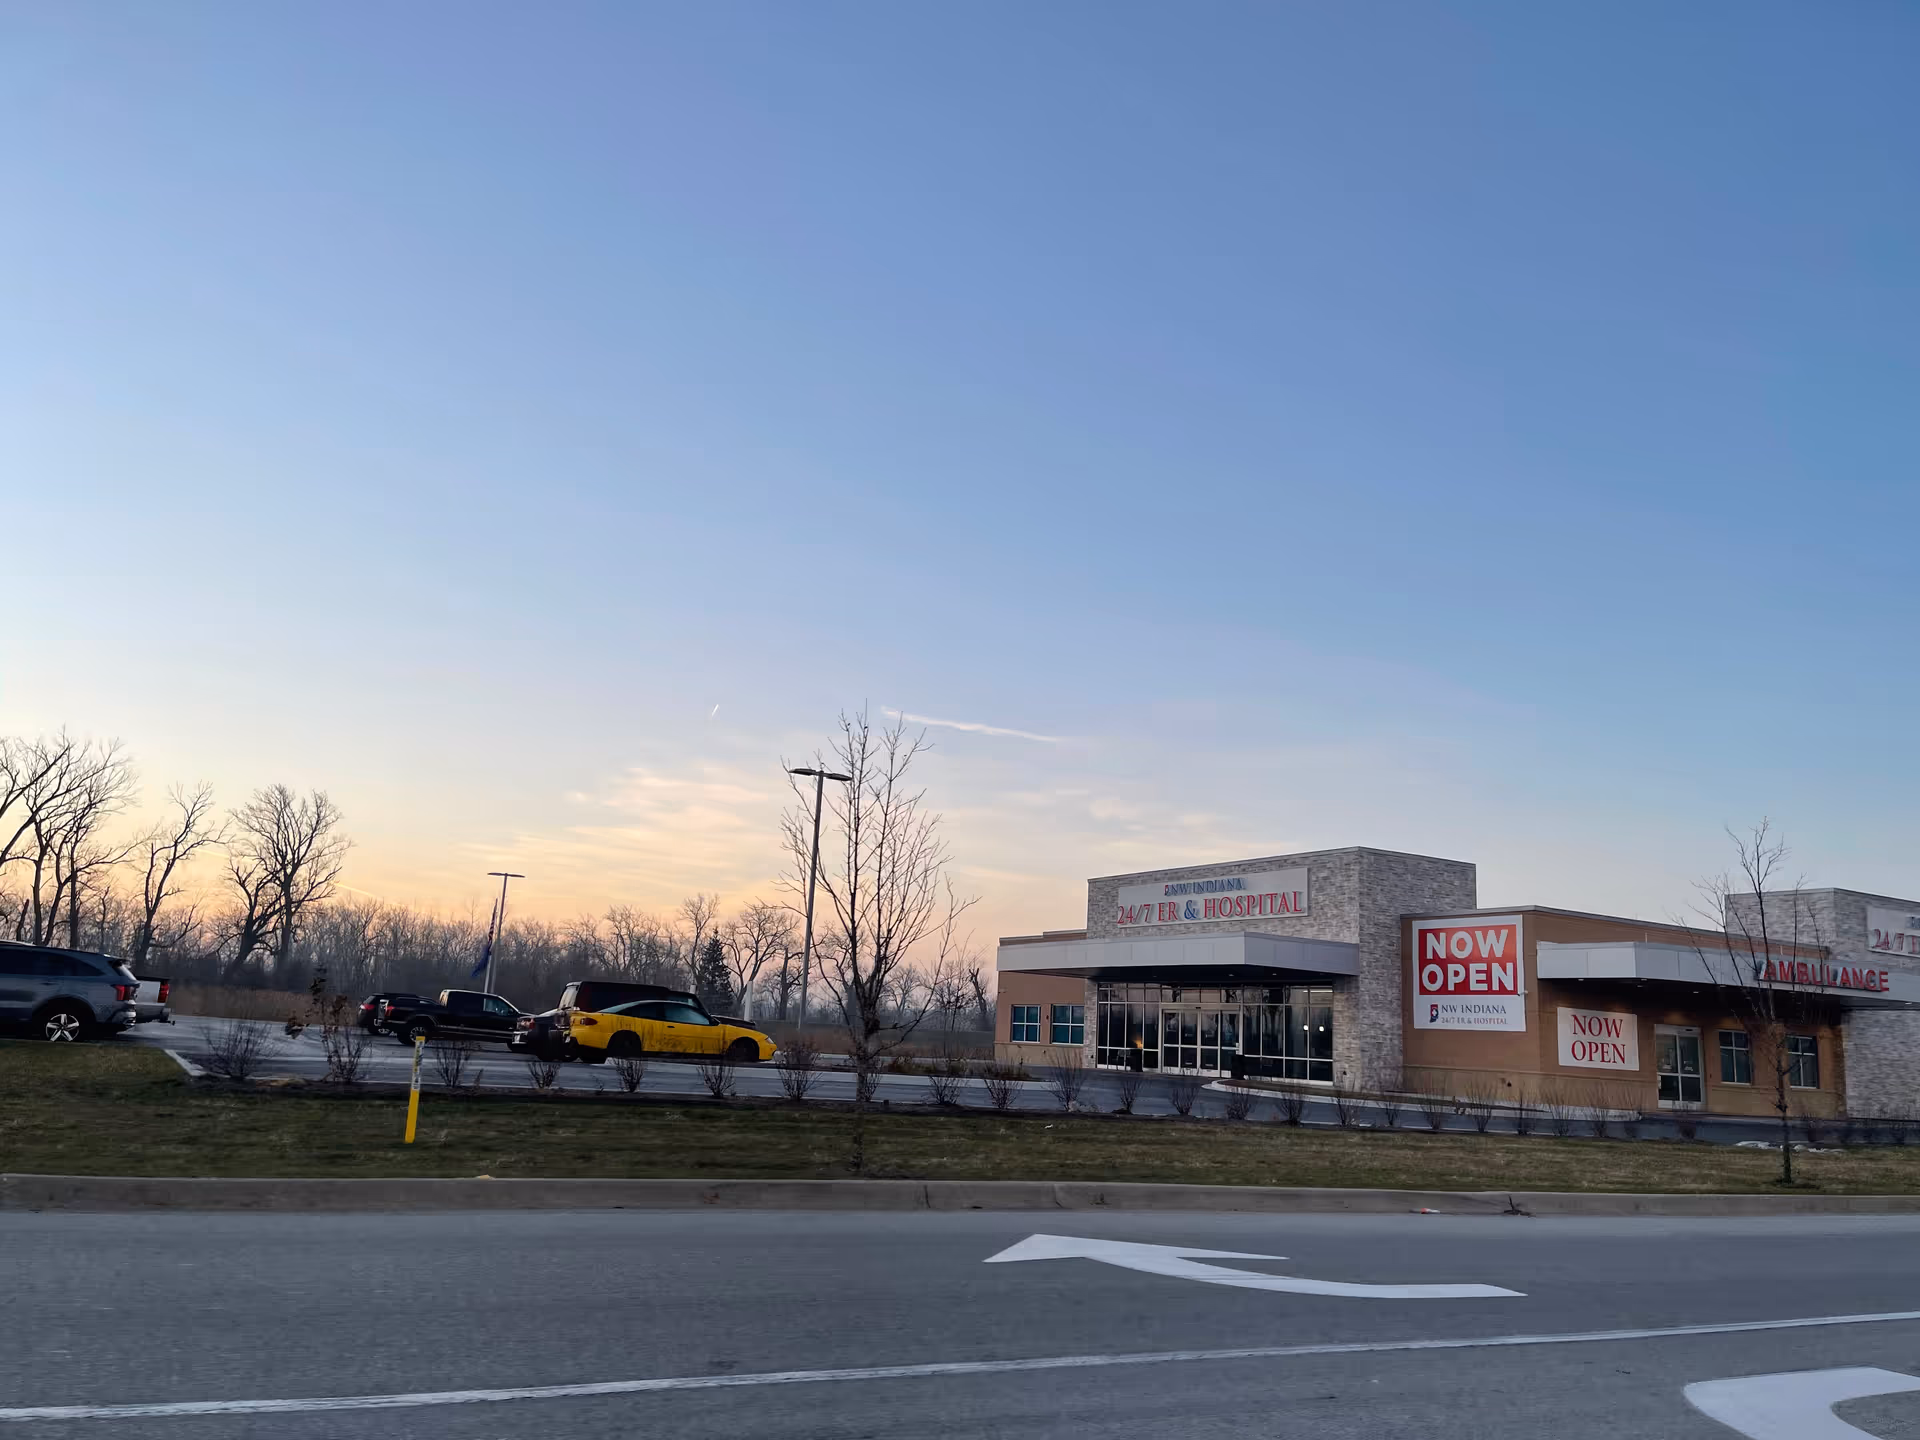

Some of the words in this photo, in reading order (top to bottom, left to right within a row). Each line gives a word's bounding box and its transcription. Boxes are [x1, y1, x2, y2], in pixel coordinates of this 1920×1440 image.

[1193, 878, 1247, 894] INDIANA
[1117, 904, 1151, 924] 24/7
[1158, 901, 1178, 922] ER
[1184, 900, 1197, 920] &
[1204, 891, 1302, 918] HOSPITAL
[1426, 929, 1508, 959] NOW
[1422, 962, 1514, 991] OPEN
[1763, 960, 1890, 992] AMBULANCE
[1441, 1004, 1457, 1013] NW
[1461, 1004, 1507, 1014] INDIANA
[1474, 1017, 1508, 1025] HOSPITAL
[1571, 1014, 1623, 1038] NOW
[1571, 1040, 1626, 1064] OPEN
